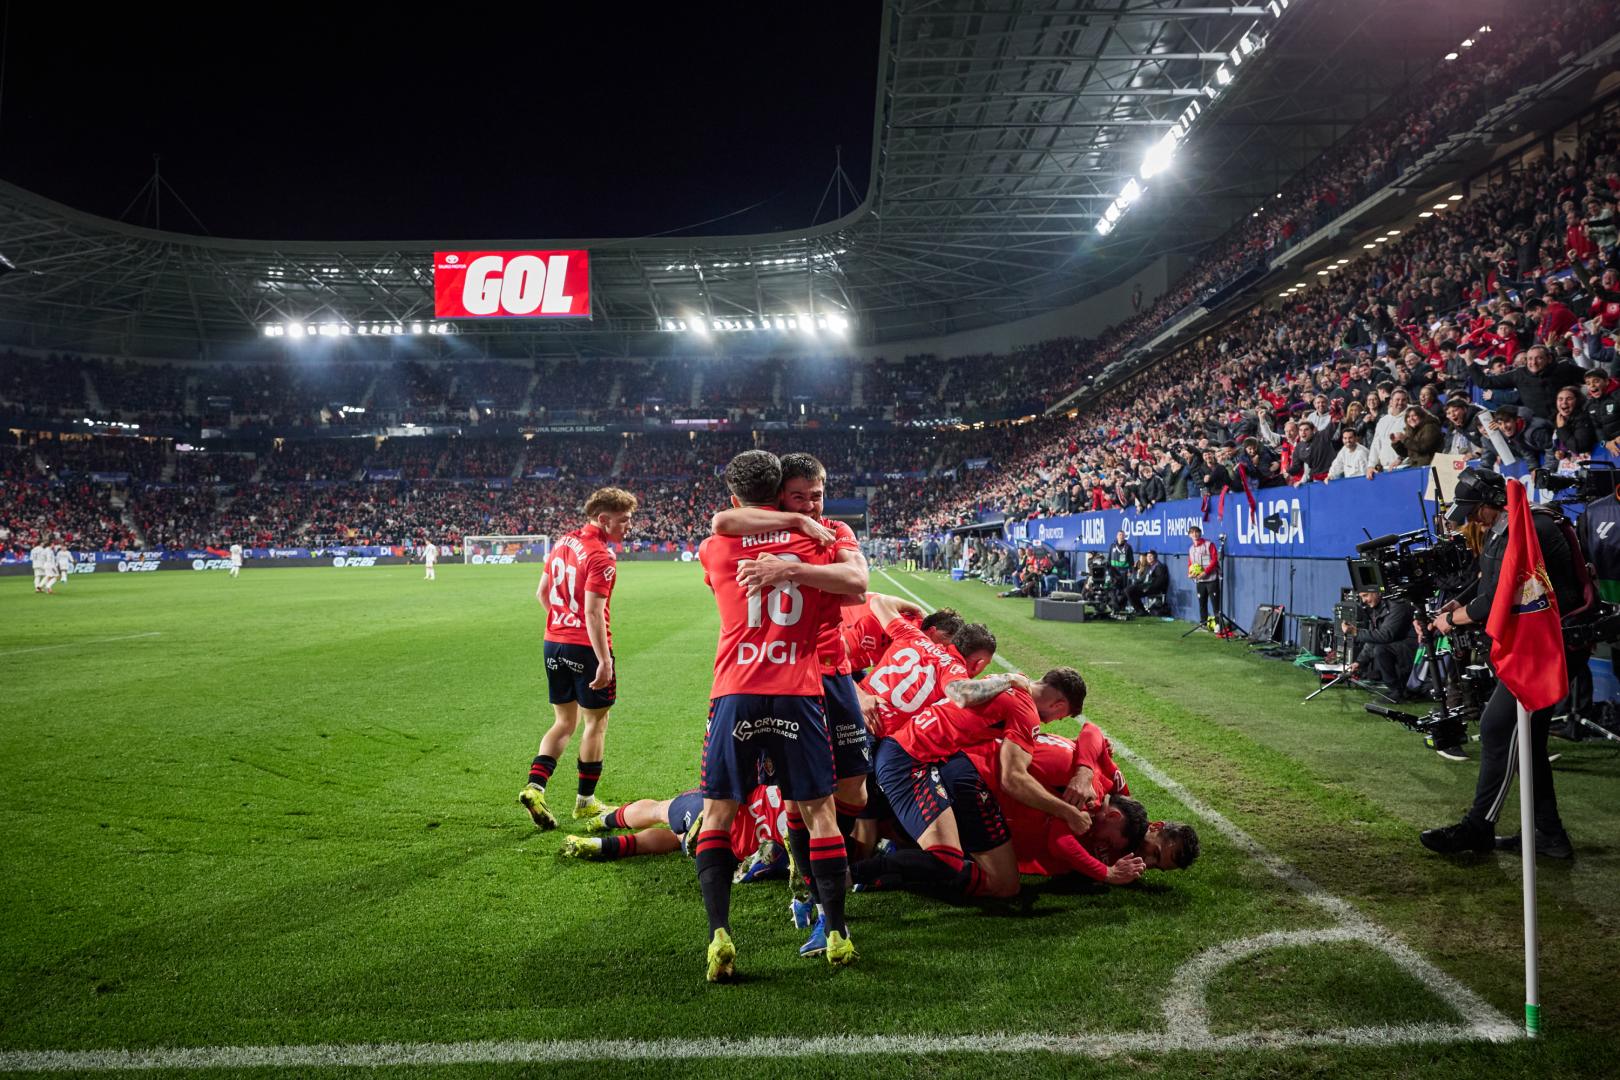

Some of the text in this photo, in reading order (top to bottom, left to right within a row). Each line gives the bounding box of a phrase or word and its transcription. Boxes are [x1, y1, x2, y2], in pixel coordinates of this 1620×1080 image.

[462, 255, 573, 314] GOL
[1081, 518, 1105, 544] LALIGA
[1130, 519, 1161, 536] LEXUS
[1236, 499, 1304, 544] LALIGA
[549, 557, 579, 613] 21
[737, 641, 797, 665] DIGI
[869, 647, 936, 712] 20
[754, 717, 800, 731] CRYPTO
[772, 728, 798, 740] TRADER
